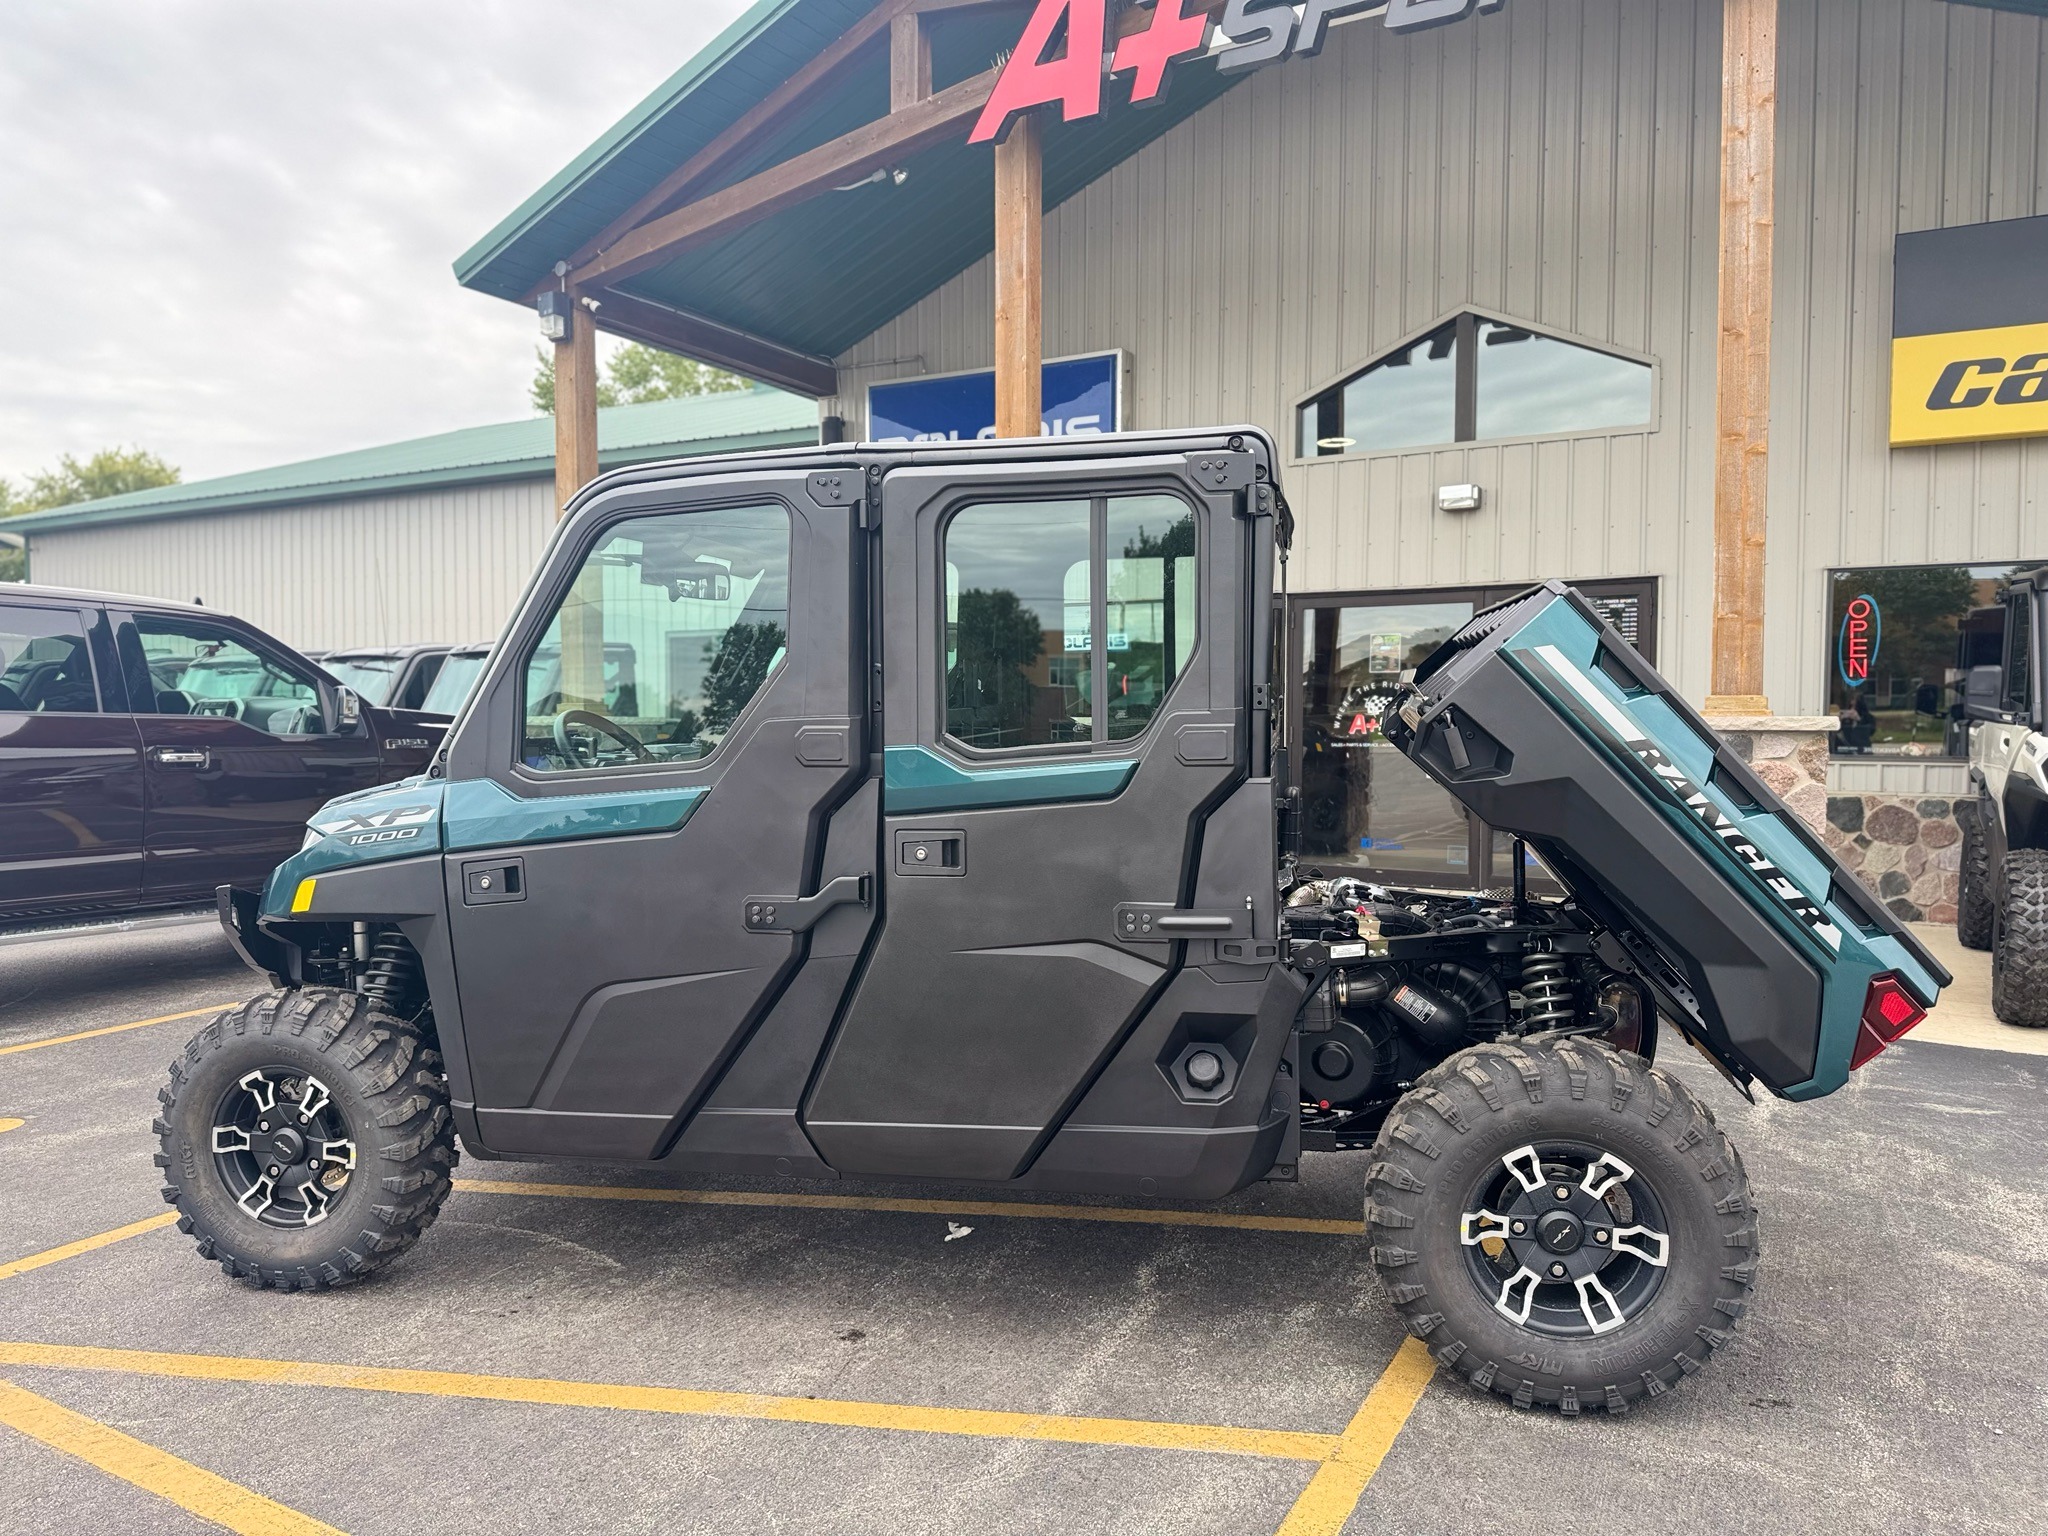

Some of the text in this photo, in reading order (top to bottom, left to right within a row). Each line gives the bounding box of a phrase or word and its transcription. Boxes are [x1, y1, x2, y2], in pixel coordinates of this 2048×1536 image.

[1848, 598, 1870, 679] OPEN
[1333, 681, 1401, 729] WHERE THE RID
[334, 804, 433, 833] XP
[349, 827, 419, 846] 1000
[1625, 738, 1834, 928] RANGER
[1438, 1119, 1525, 1196] PRO ARMOR
[1591, 1296, 1700, 1377] X-TERRAIN
